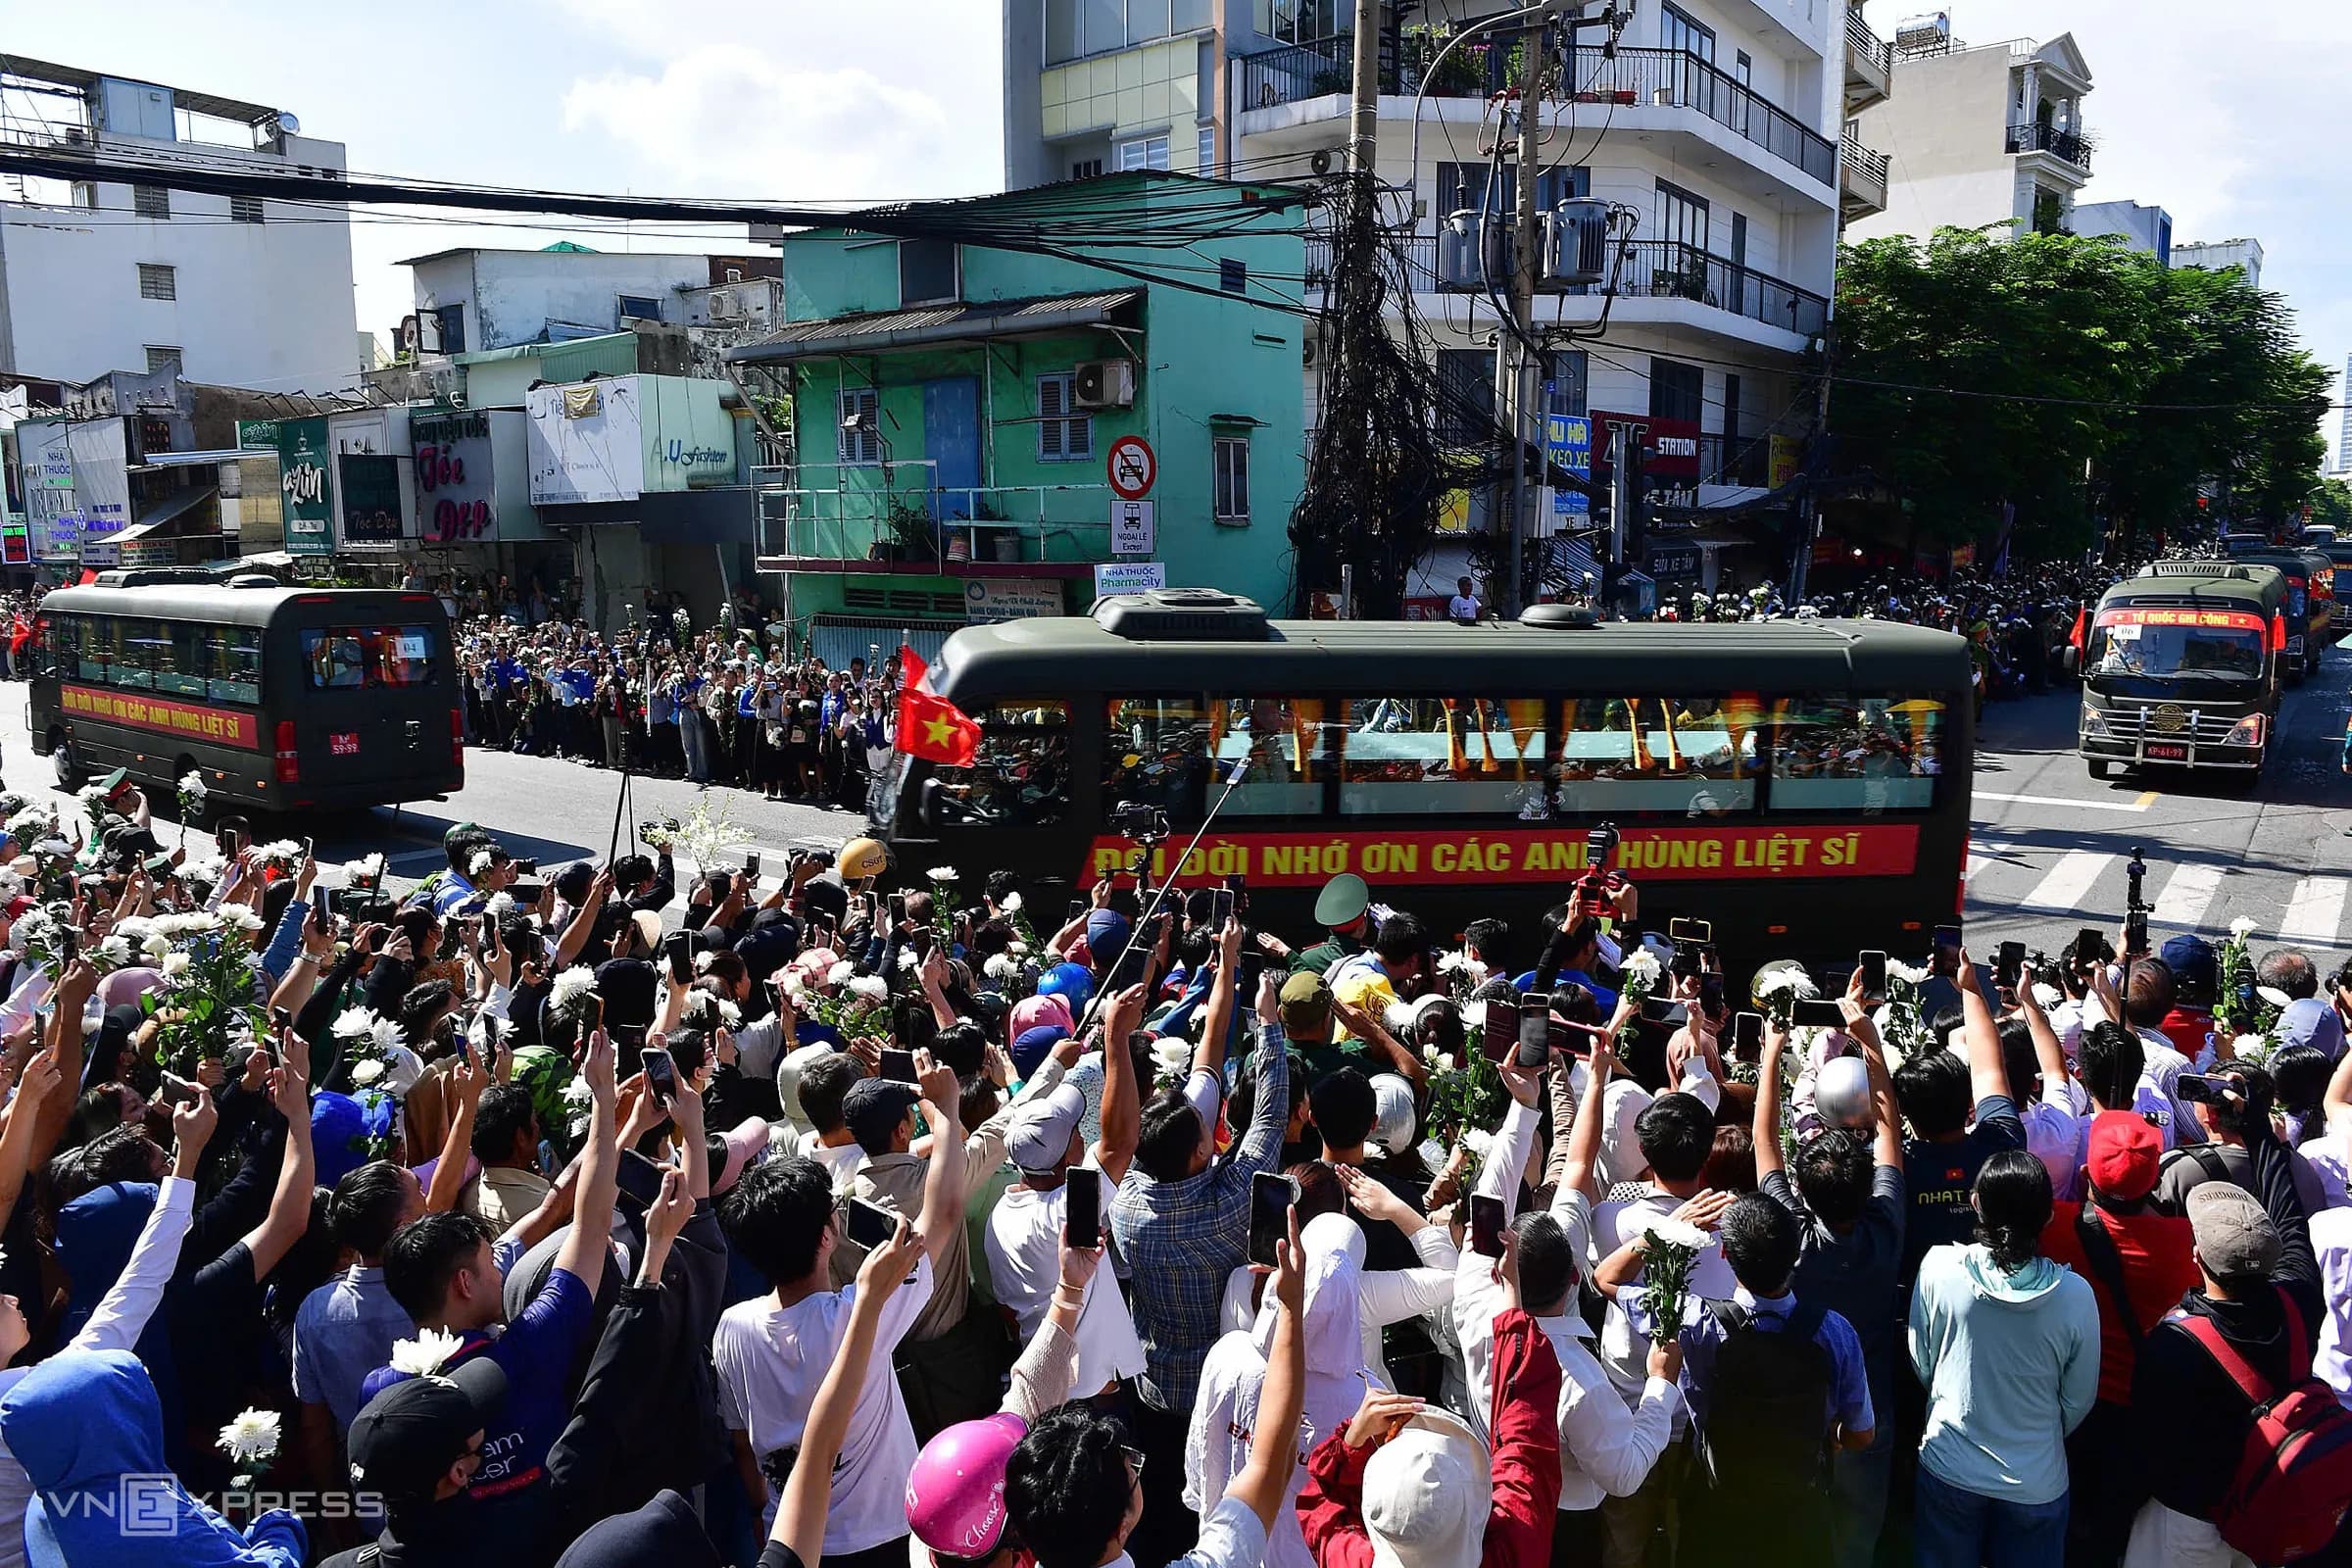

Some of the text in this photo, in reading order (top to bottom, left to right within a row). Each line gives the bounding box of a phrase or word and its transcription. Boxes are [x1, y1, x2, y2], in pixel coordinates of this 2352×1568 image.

[1656, 437, 1696, 457] STATION
[1576, 451, 1590, 468] XE
[1105, 565, 1155, 576] NHÀ THUỐC
[1101, 576, 1160, 588] Pharmacity
[1425, 605, 1446, 620] Sho
[2132, 610, 2230, 625] TỔ QUỐC GHI CÔNG
[93, 693, 112, 714] NHỚ
[127, 700, 147, 720] CÁC
[149, 706, 170, 726] ANH
[171, 707, 200, 734] HÙNG
[202, 712, 224, 738] LIỆT
[226, 715, 239, 739] SĨ
[1179, 839, 1249, 876] ĐỜI
[1262, 838, 1350, 875] NHỚ
[1361, 841, 1418, 873] ƠN
[1431, 837, 1512, 872] CÁC
[1617, 835, 1723, 870] HÙNG
[1735, 835, 1811, 872] LIỆT
[1820, 832, 1861, 866] SĨ
[861, 856, 883, 869] CSGT
